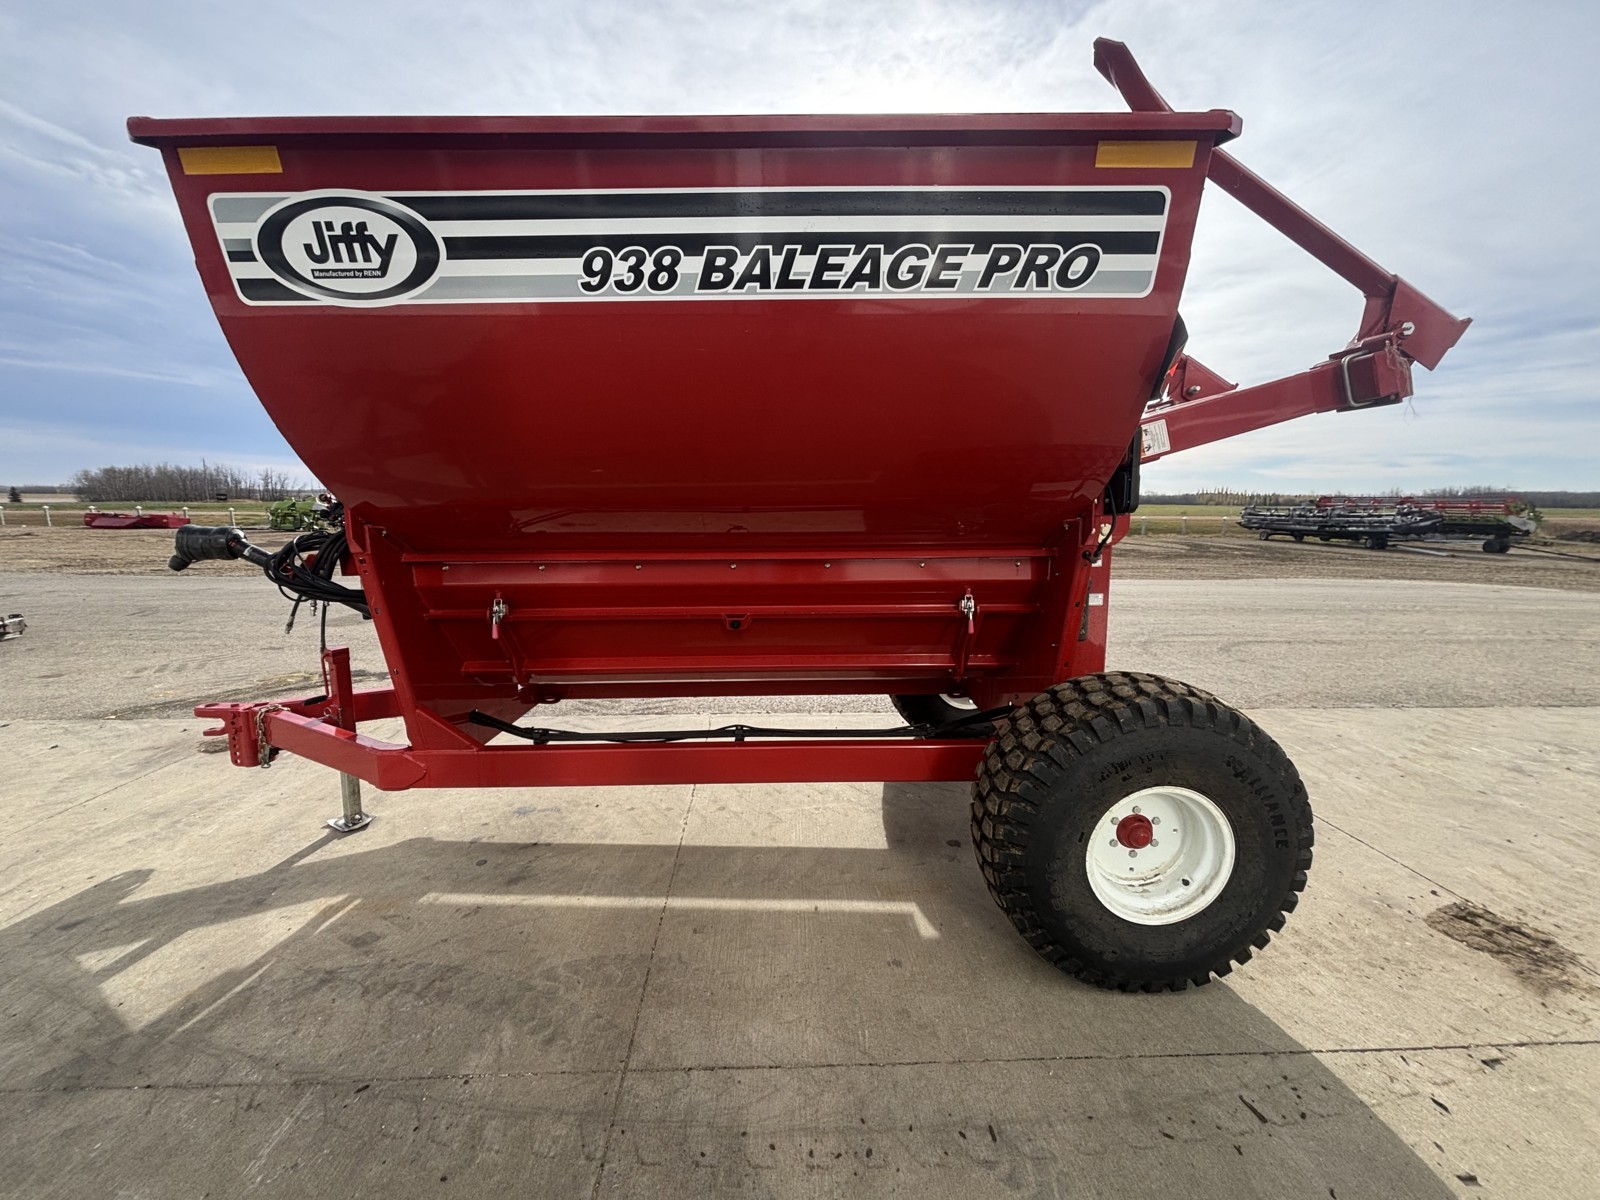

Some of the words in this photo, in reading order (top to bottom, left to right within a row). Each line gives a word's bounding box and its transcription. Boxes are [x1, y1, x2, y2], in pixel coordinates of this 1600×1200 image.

[303, 221, 398, 277] Jiffy
[355, 270, 362, 278] by
[580, 247, 683, 293] 938
[697, 245, 970, 292] BALEAGE
[975, 244, 1102, 290] PRO
[1233, 769, 1289, 849] ALLIANCE
